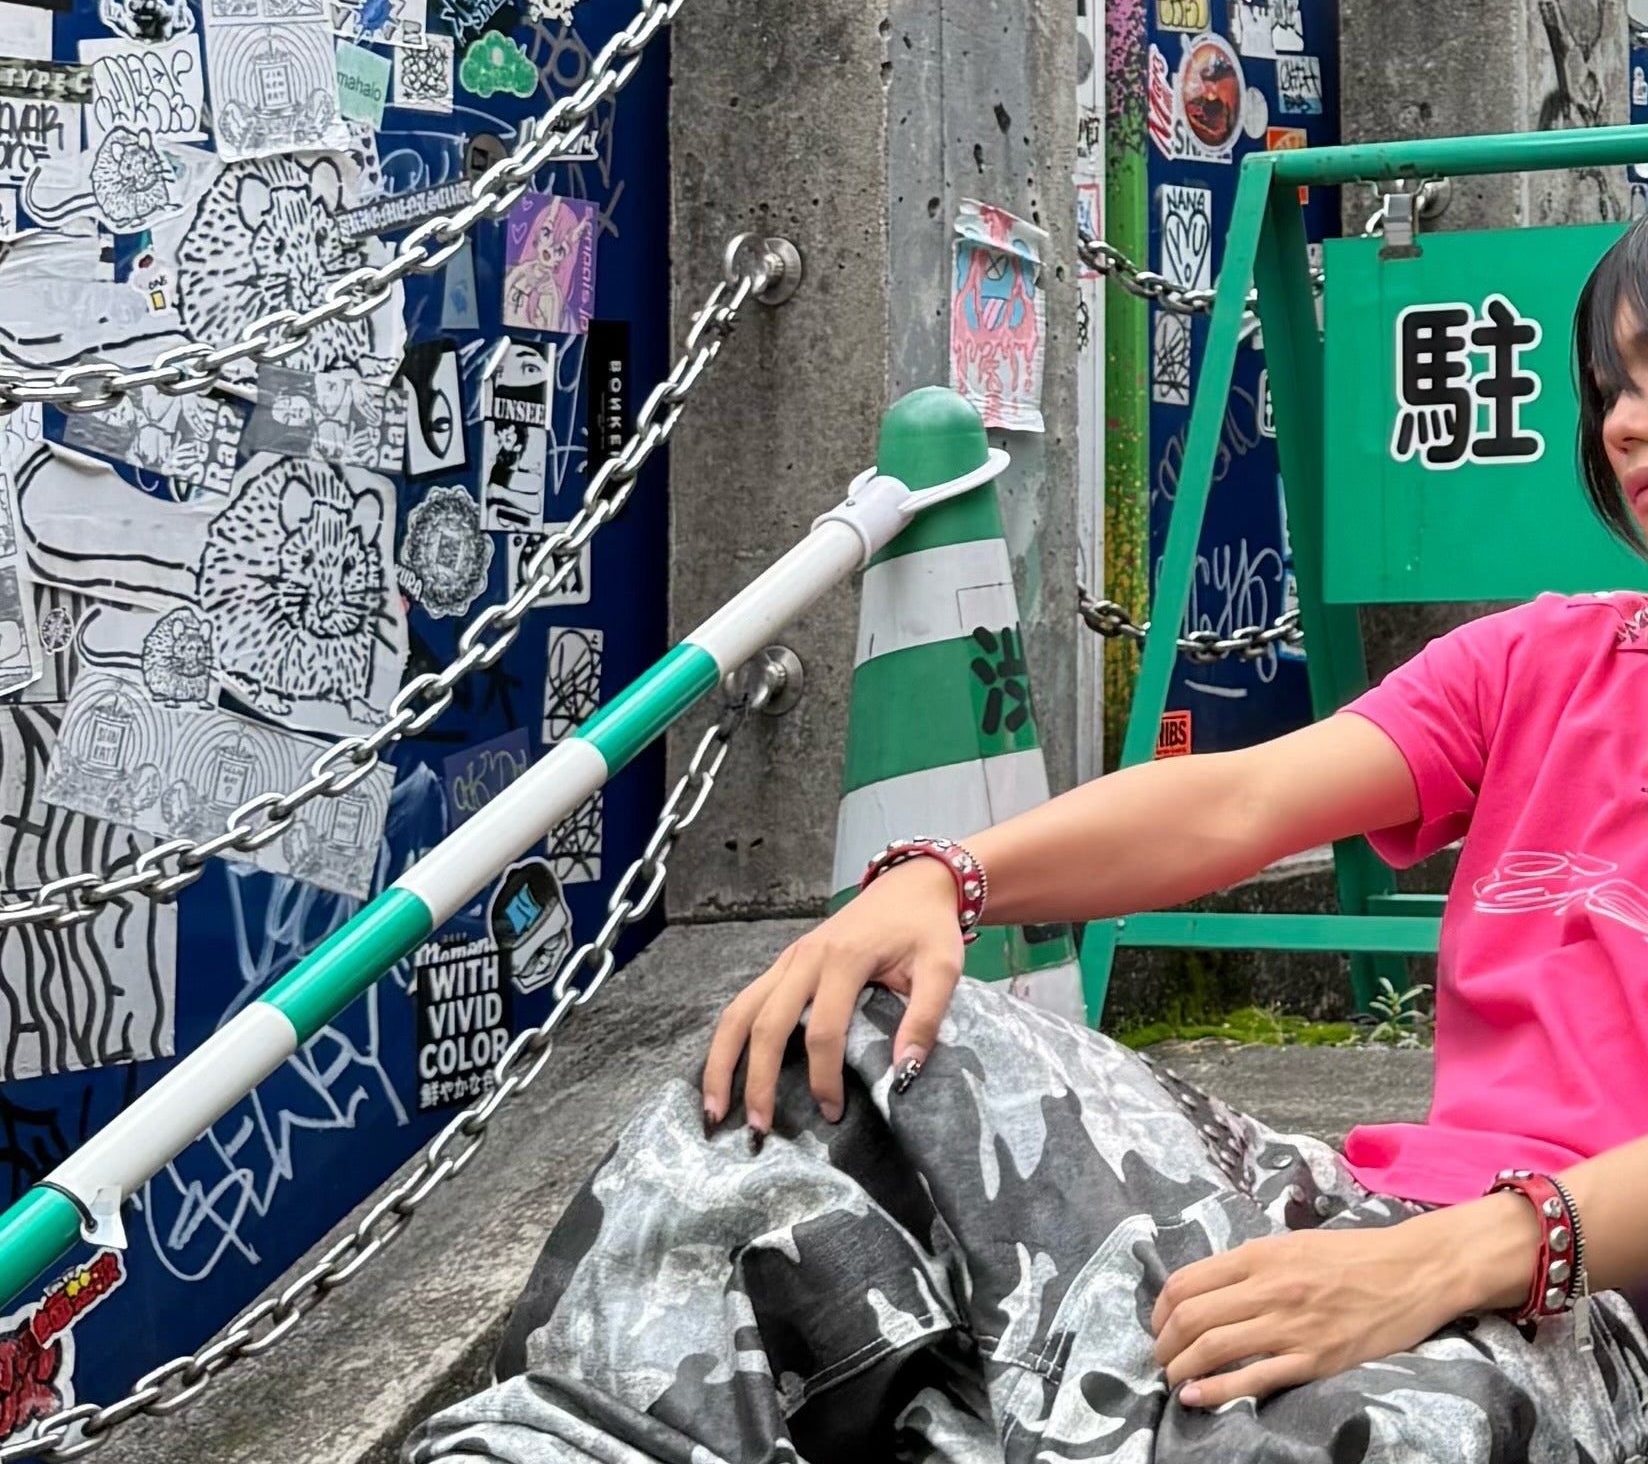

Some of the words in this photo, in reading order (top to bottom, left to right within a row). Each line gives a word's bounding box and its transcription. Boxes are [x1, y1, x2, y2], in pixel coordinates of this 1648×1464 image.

[337, 71, 382, 101] mahalo
[1392, 294, 1544, 471] 駐
[203, 405, 243, 492] Rat?
[429, 954, 499, 1002] WITH
[427, 992, 503, 1039] VIVID
[419, 1028, 509, 1079] COLOR
